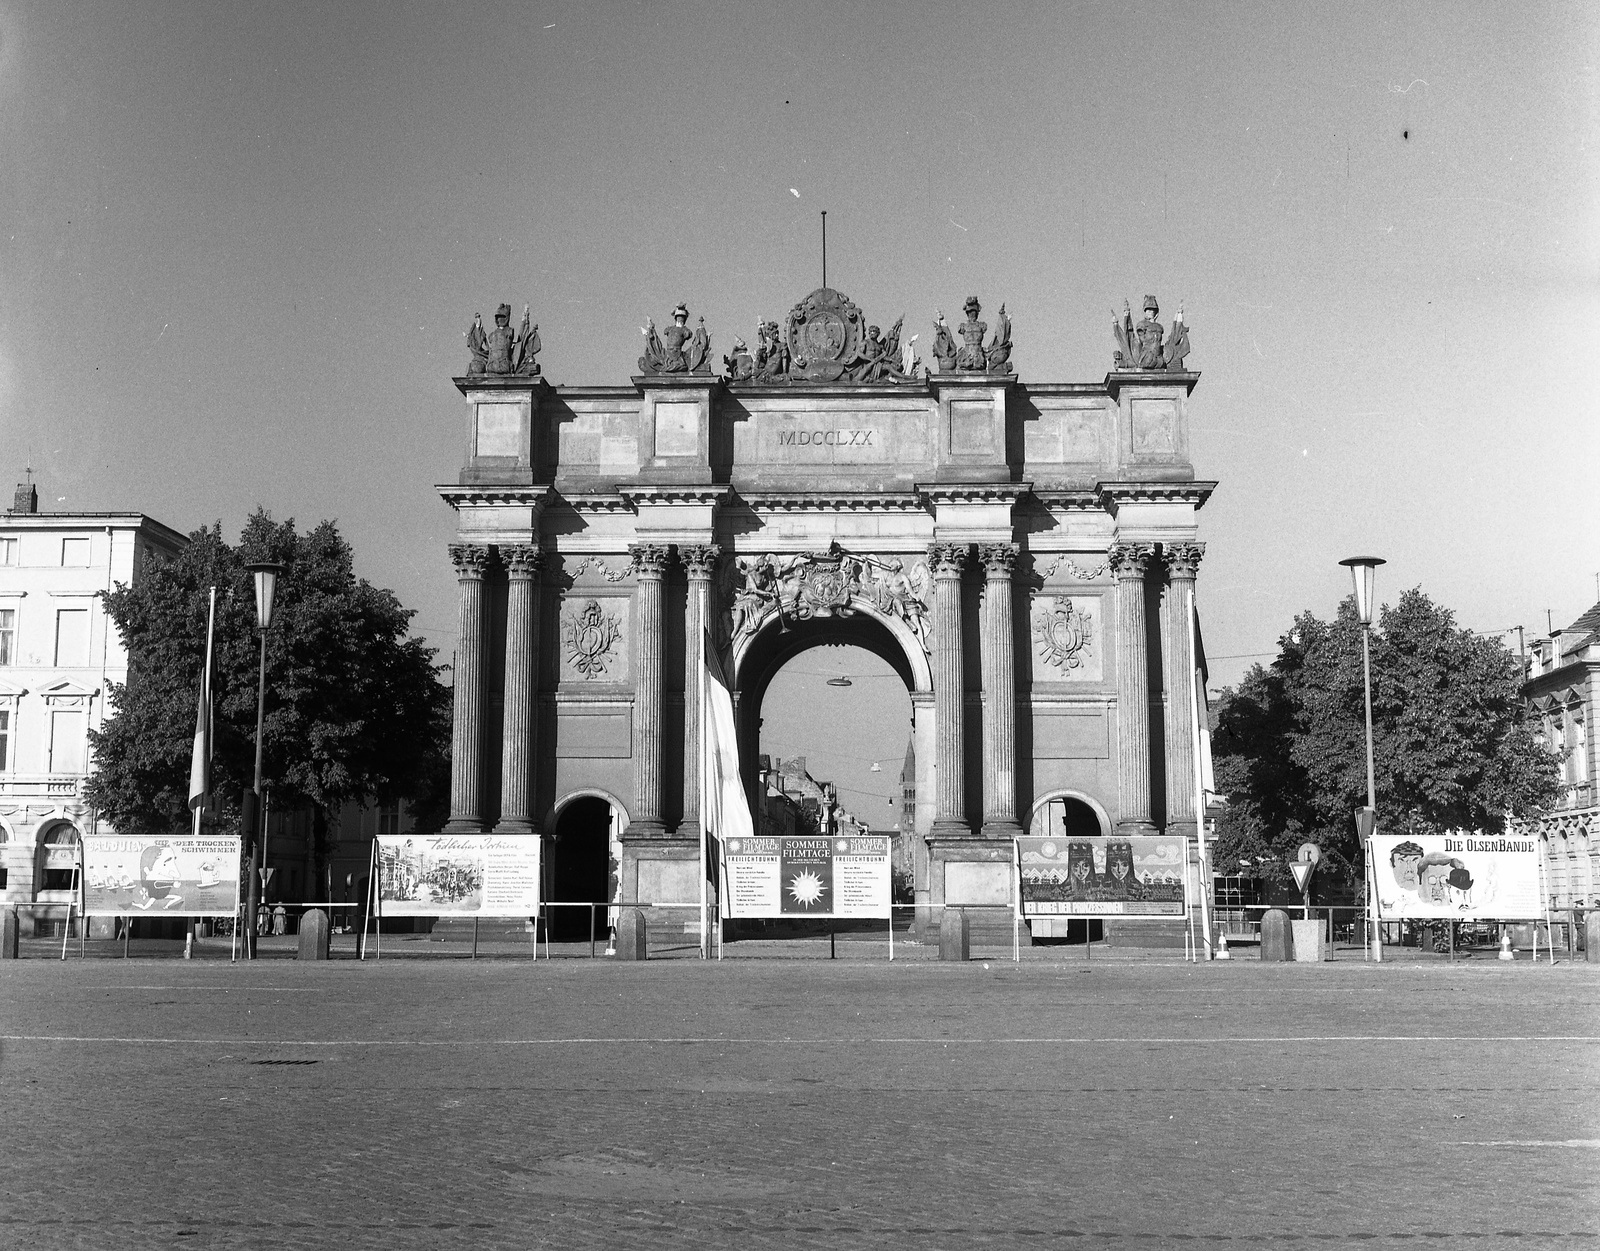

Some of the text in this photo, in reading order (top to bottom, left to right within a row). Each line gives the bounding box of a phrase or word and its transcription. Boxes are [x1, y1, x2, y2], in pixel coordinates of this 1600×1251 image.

[779, 430, 873, 446] MDCCLXX
[426, 837, 477, 853] Tödlicher
[785, 841, 828, 849] SOMMER
[1444, 838, 1463, 852] DIE
[783, 850, 831, 858] FILMTAGE
